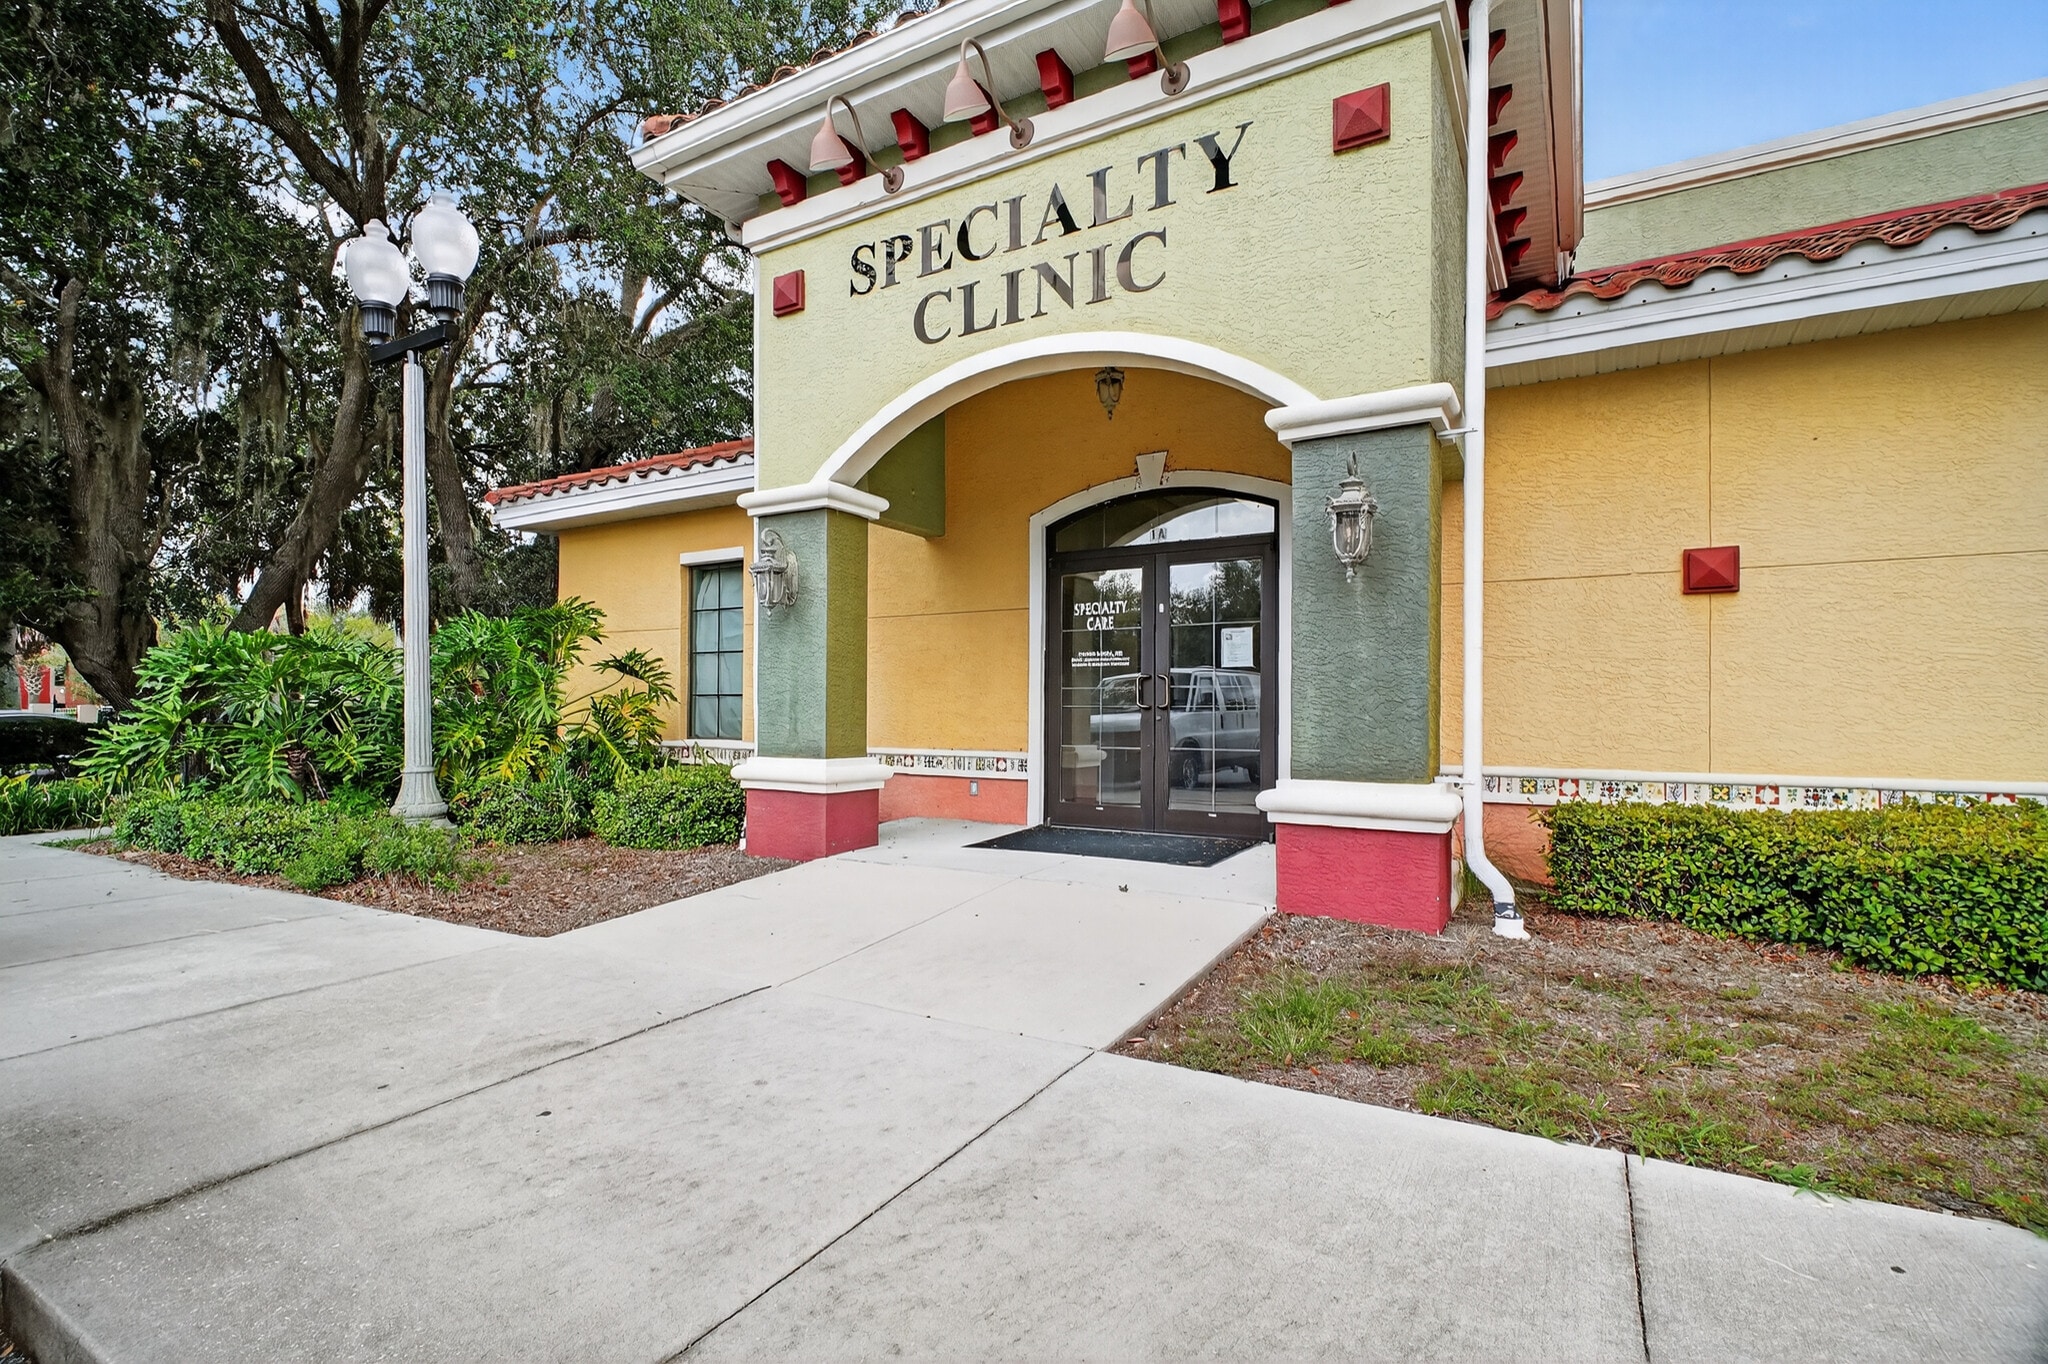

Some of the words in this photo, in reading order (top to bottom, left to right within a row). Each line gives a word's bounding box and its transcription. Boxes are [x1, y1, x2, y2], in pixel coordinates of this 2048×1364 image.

[849, 120, 1254, 298] SPECIALTY
[913, 226, 1167, 345] CLINIC
[1074, 600, 1127, 616] SPECIALTY
[1087, 615, 1114, 631] CARE
